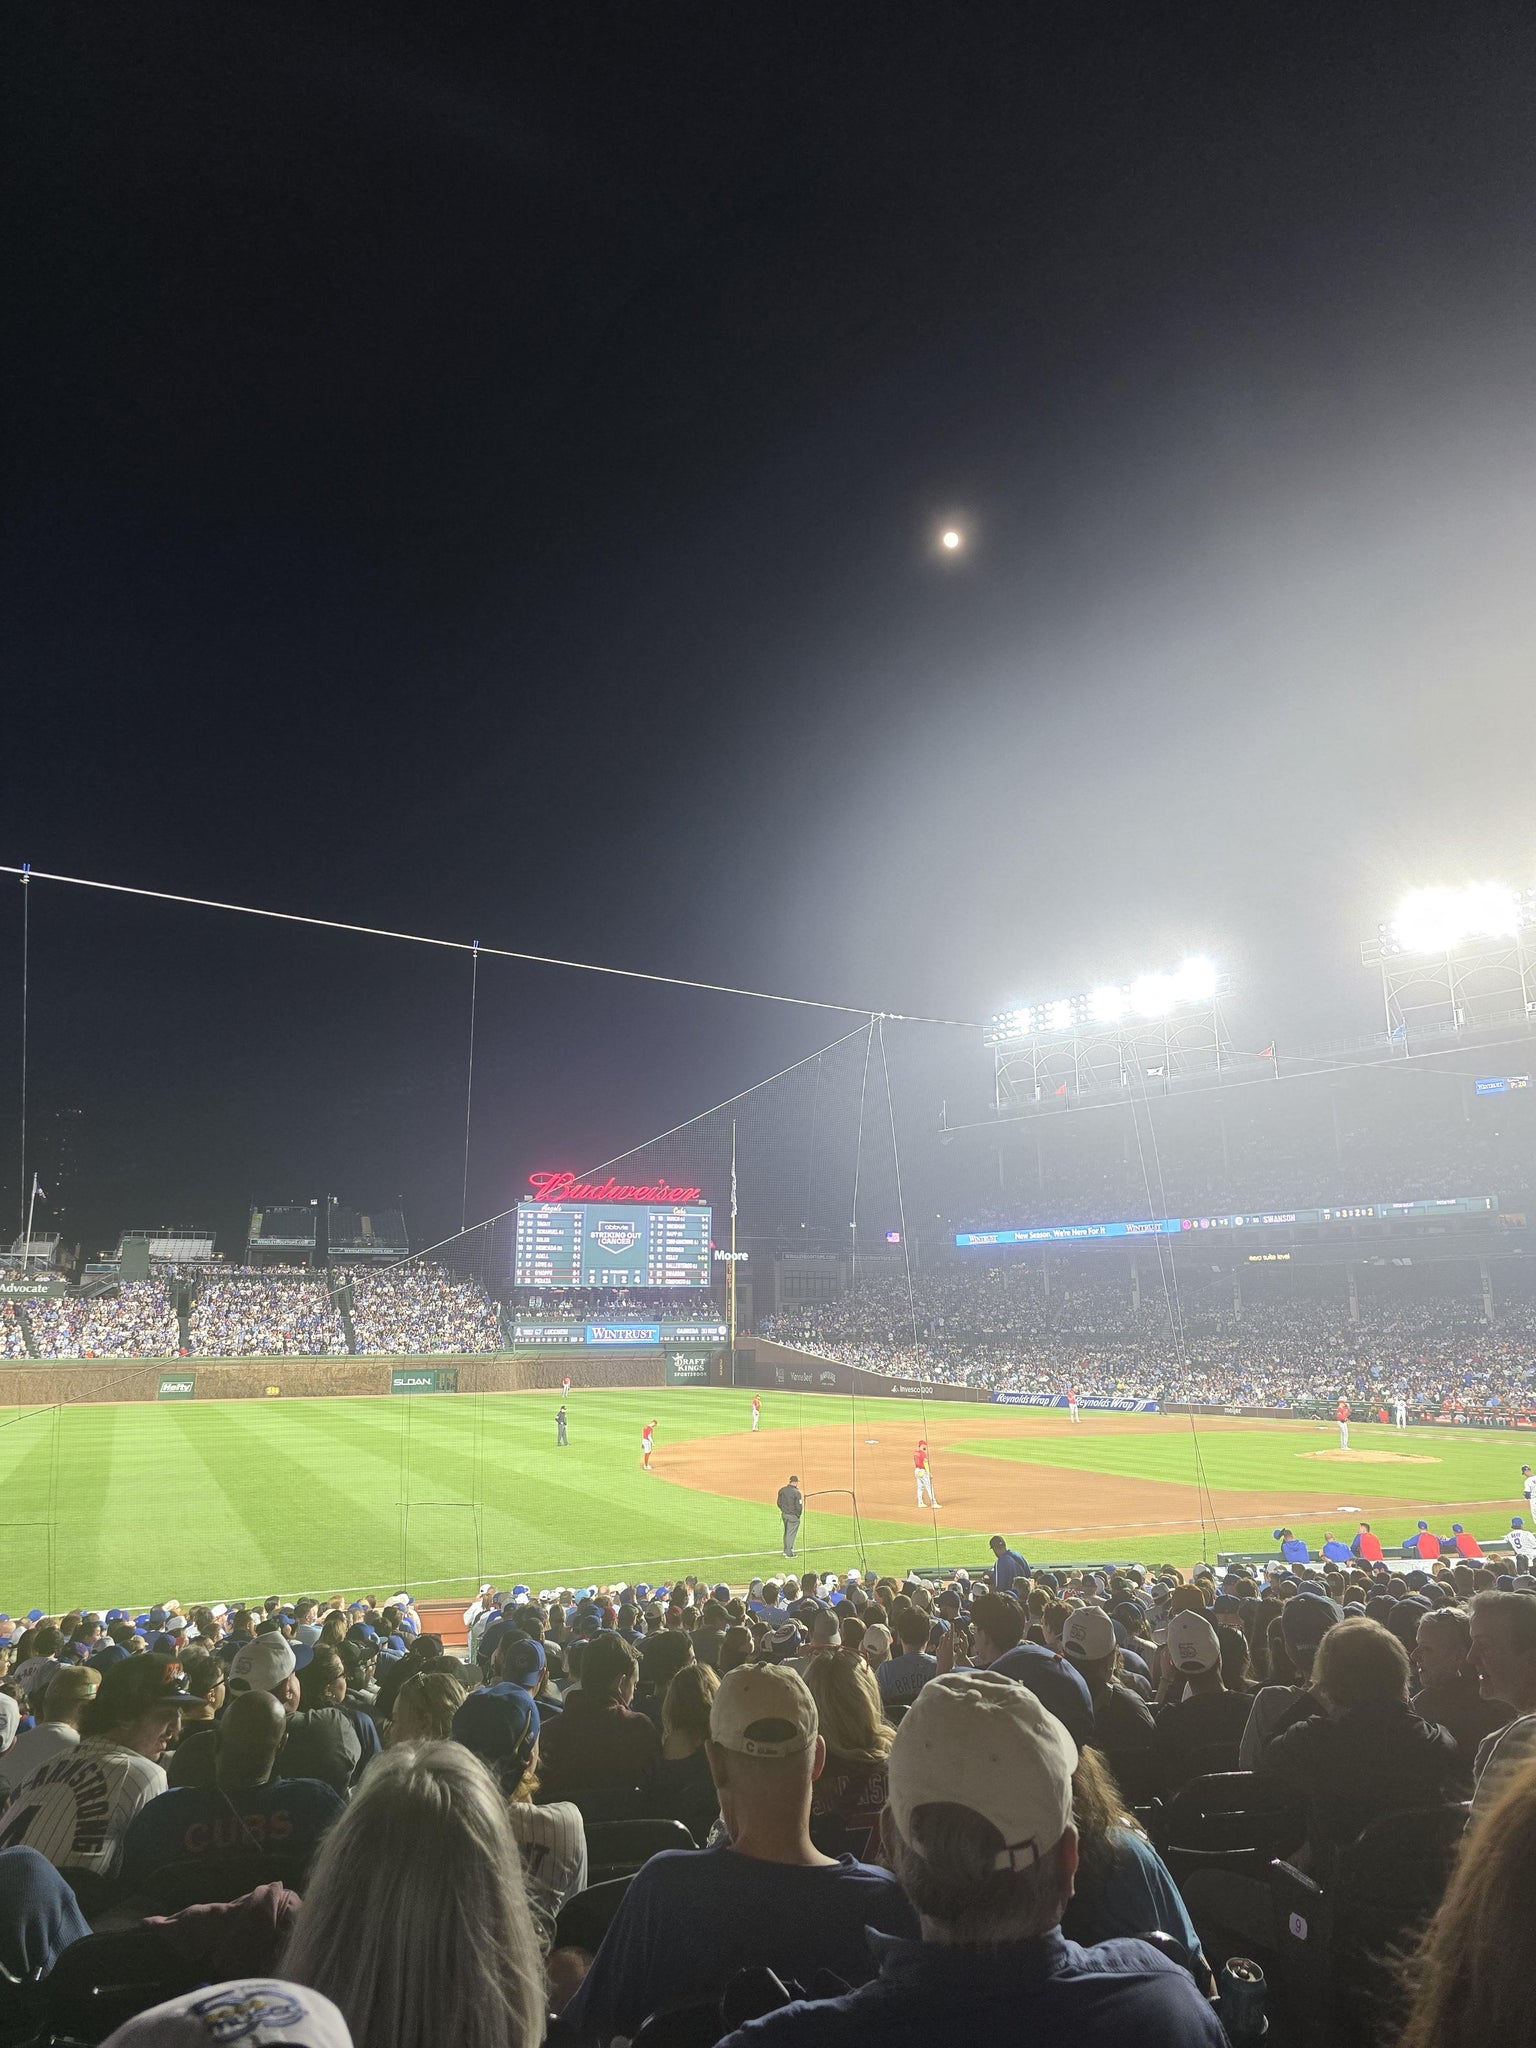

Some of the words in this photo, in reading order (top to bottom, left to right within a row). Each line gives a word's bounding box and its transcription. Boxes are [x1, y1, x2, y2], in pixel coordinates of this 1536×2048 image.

[529, 1172, 702, 1202] Budweiser
[1263, 1214, 1296, 1224] SWANSON
[590, 1231, 626, 1239] STRIKING
[1029, 1231, 1052, 1240] Season,
[1053, 1229, 1070, 1238] We're
[1070, 1228, 1087, 1236] Here
[715, 1249, 749, 1262] Moore
[589, 1275, 596, 1284] 2
[602, 1275, 608, 1284] 2
[621, 1275, 627, 1284] 2
[633, 1275, 641, 1284] 4
[0, 1283, 48, 1293] Advocate
[591, 1327, 656, 1340] WINTRUST
[674, 1358, 706, 1367] DRAFT
[677, 1364, 705, 1372] KINGS
[162, 1383, 191, 1392] Hefty
[899, 1385, 920, 1393] Invesco
[921, 1386, 933, 1394] QQQ
[996, 1393, 1029, 1404] Reynolds
[1029, 1394, 1050, 1406] Wrap
[1075, 1397, 1110, 1408] Reynolds
[1110, 1398, 1134, 1411] Wrap
[1514, 1538, 1522, 1549] 9
[184, 1809, 293, 1852] CUBS
[1295, 1918, 1302, 1934] 9
